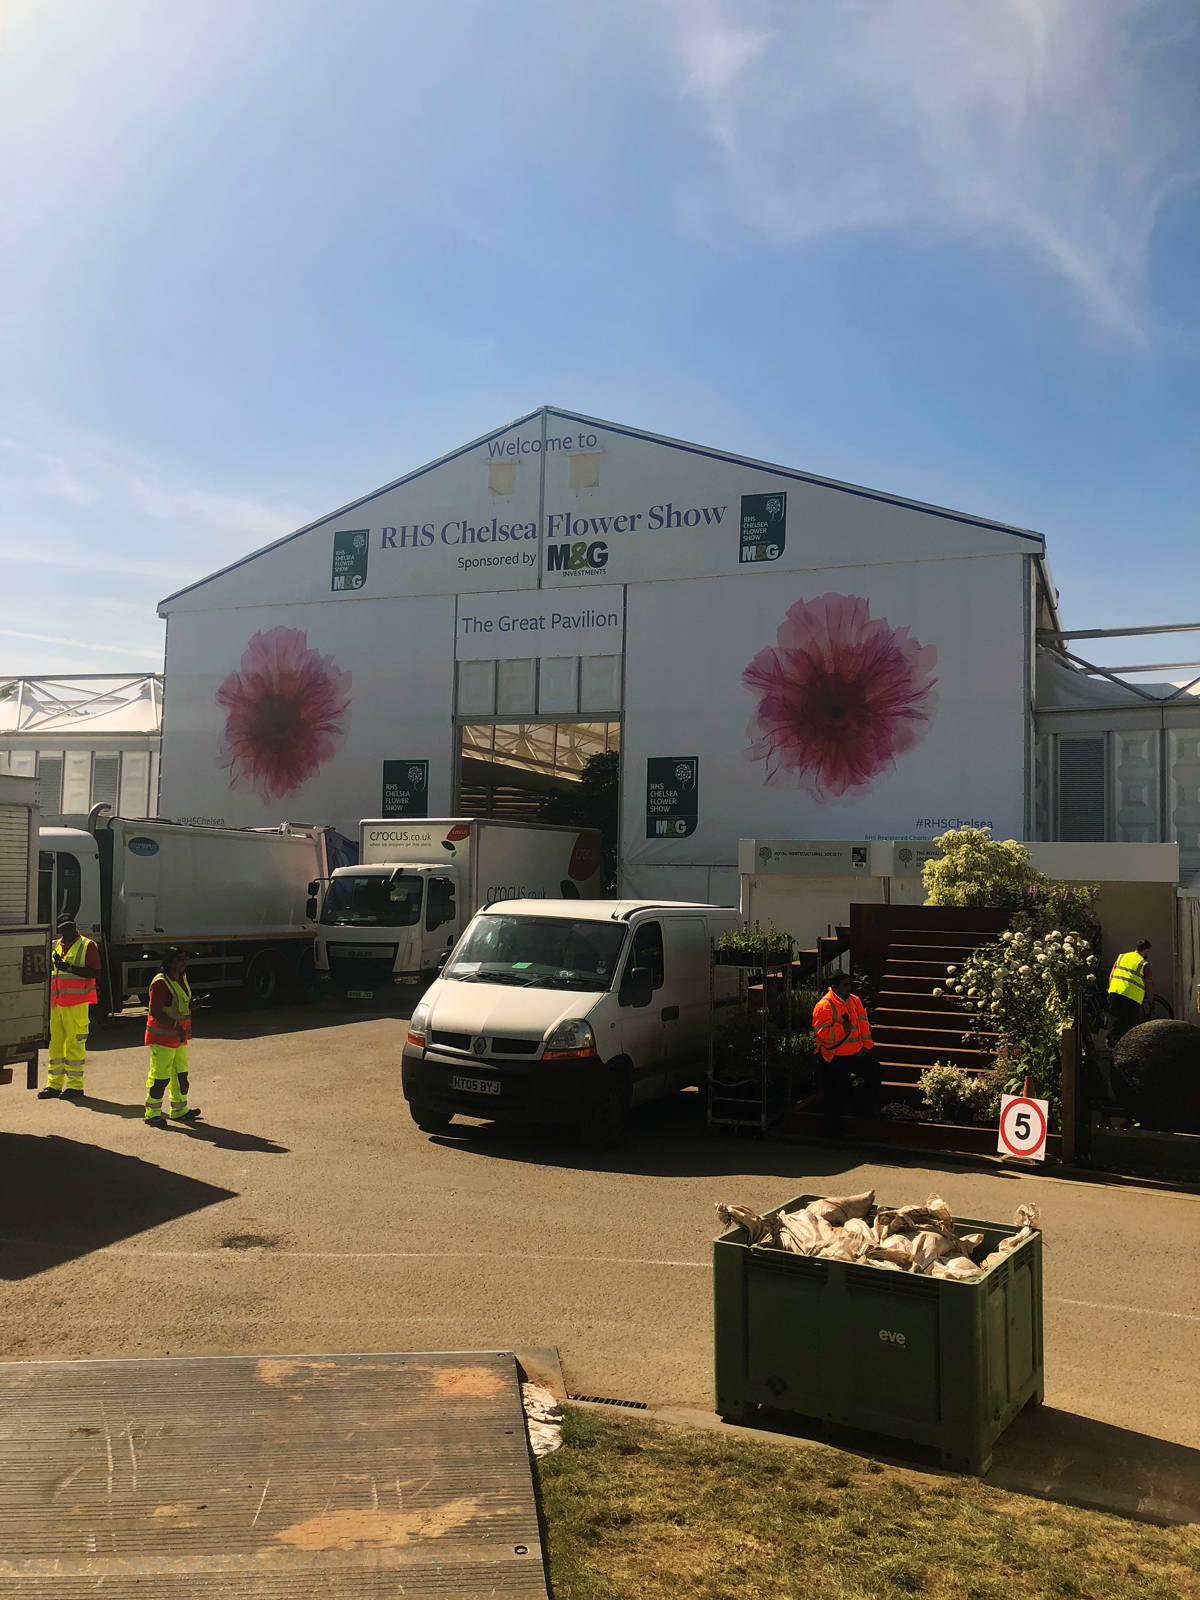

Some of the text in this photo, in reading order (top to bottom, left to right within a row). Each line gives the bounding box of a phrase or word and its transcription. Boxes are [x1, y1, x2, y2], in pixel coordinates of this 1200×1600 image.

[487, 433, 598, 458] Welcome to
[380, 503, 728, 550] RHS Chelsea Flower Show
[743, 521, 769, 529] CHELSEA
[742, 534, 762, 542] SHOW
[547, 541, 609, 571] M&G
[742, 544, 779, 562] M&G
[457, 551, 537, 571] Sponsored by
[562, 568, 607, 577] INVESTMENTS
[333, 574, 362, 590] M&G
[462, 610, 618, 633] The Great Pavilion
[650, 782, 664, 790] RHS
[385, 790, 411, 798] CHELSEA
[650, 790, 678, 798] CHELSEA
[385, 797, 410, 805] FLOWER
[650, 797, 677, 805] FLOWER
[650, 805, 670, 813] SHOW
[176, 816, 226, 826] #RHSChelsea
[915, 818, 994, 829] #RHSChelsea
[655, 819, 687, 834] M&G
[369, 831, 432, 841] crocus.co.uk
[130, 842, 158, 850] OLYMPUS
[454, 1077, 500, 1093] HT05 BYJ
[1015, 1113, 1031, 1140] 5
[878, 1329, 906, 1345] eve
